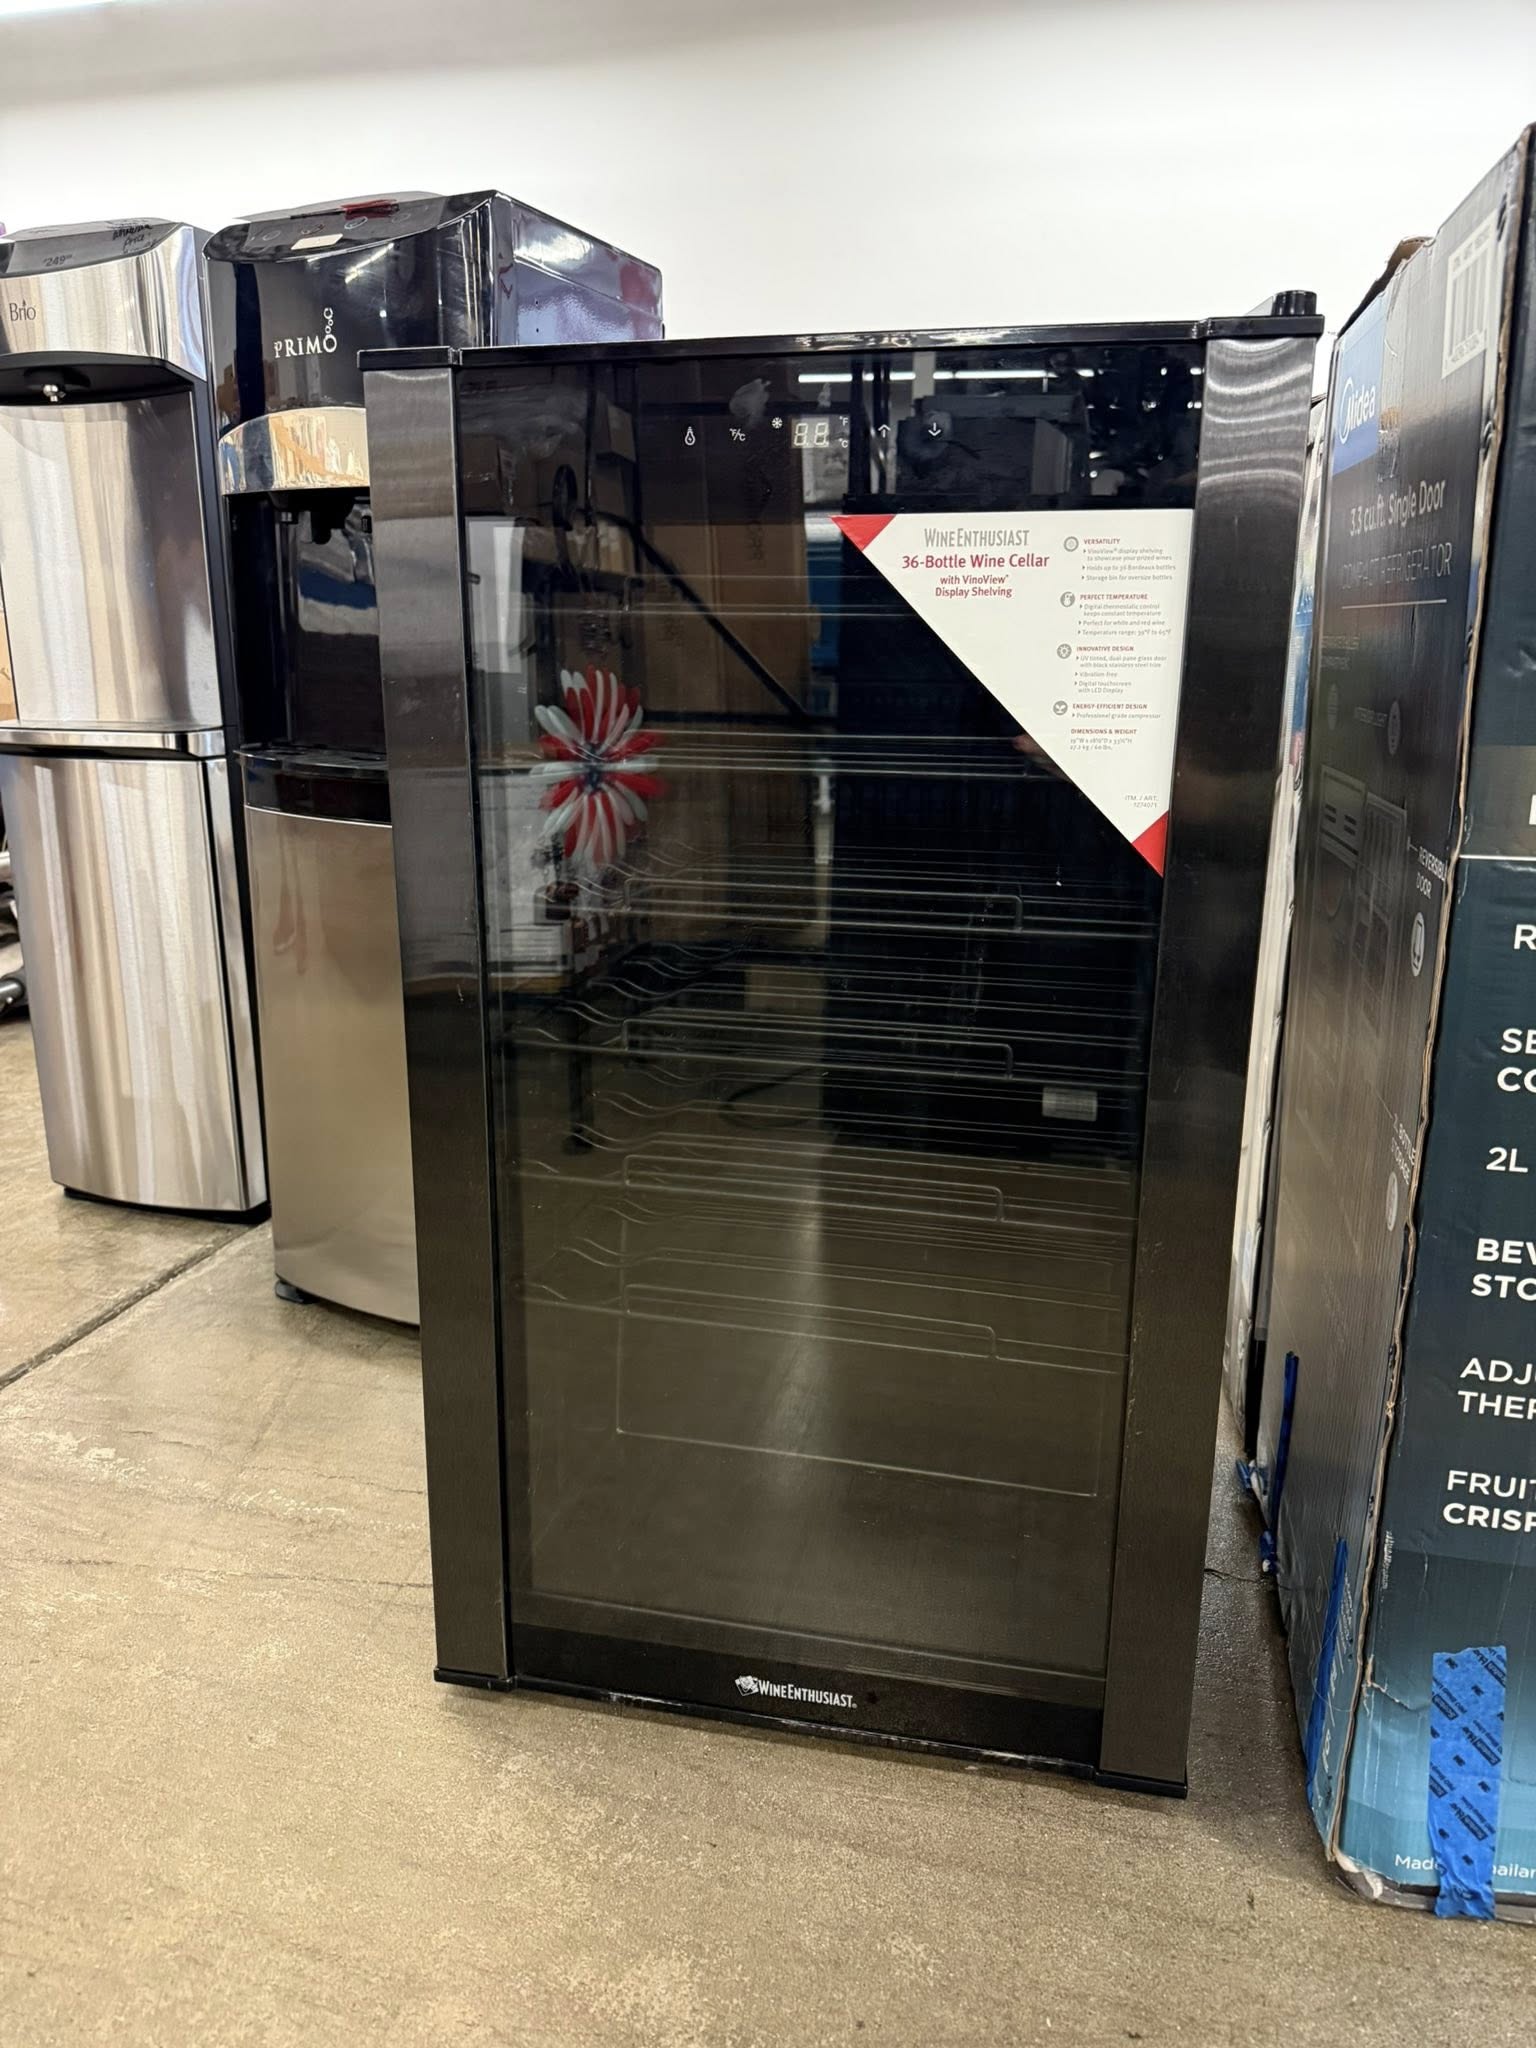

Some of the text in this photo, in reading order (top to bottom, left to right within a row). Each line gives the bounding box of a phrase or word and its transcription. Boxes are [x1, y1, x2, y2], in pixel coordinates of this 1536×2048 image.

[9, 300, 36, 321] Brio
[273, 334, 338, 359] PRIMO
[1338, 376, 1376, 444] Midea
[1388, 485, 1416, 528] Single
[1419, 480, 1446, 516] Door
[902, 553, 1050, 569] 36-Bottle Wine Cellar
[940, 575, 960, 585] with
[935, 587, 1013, 599] Display Shelving
[1486, 1147, 1528, 1173] 2L
